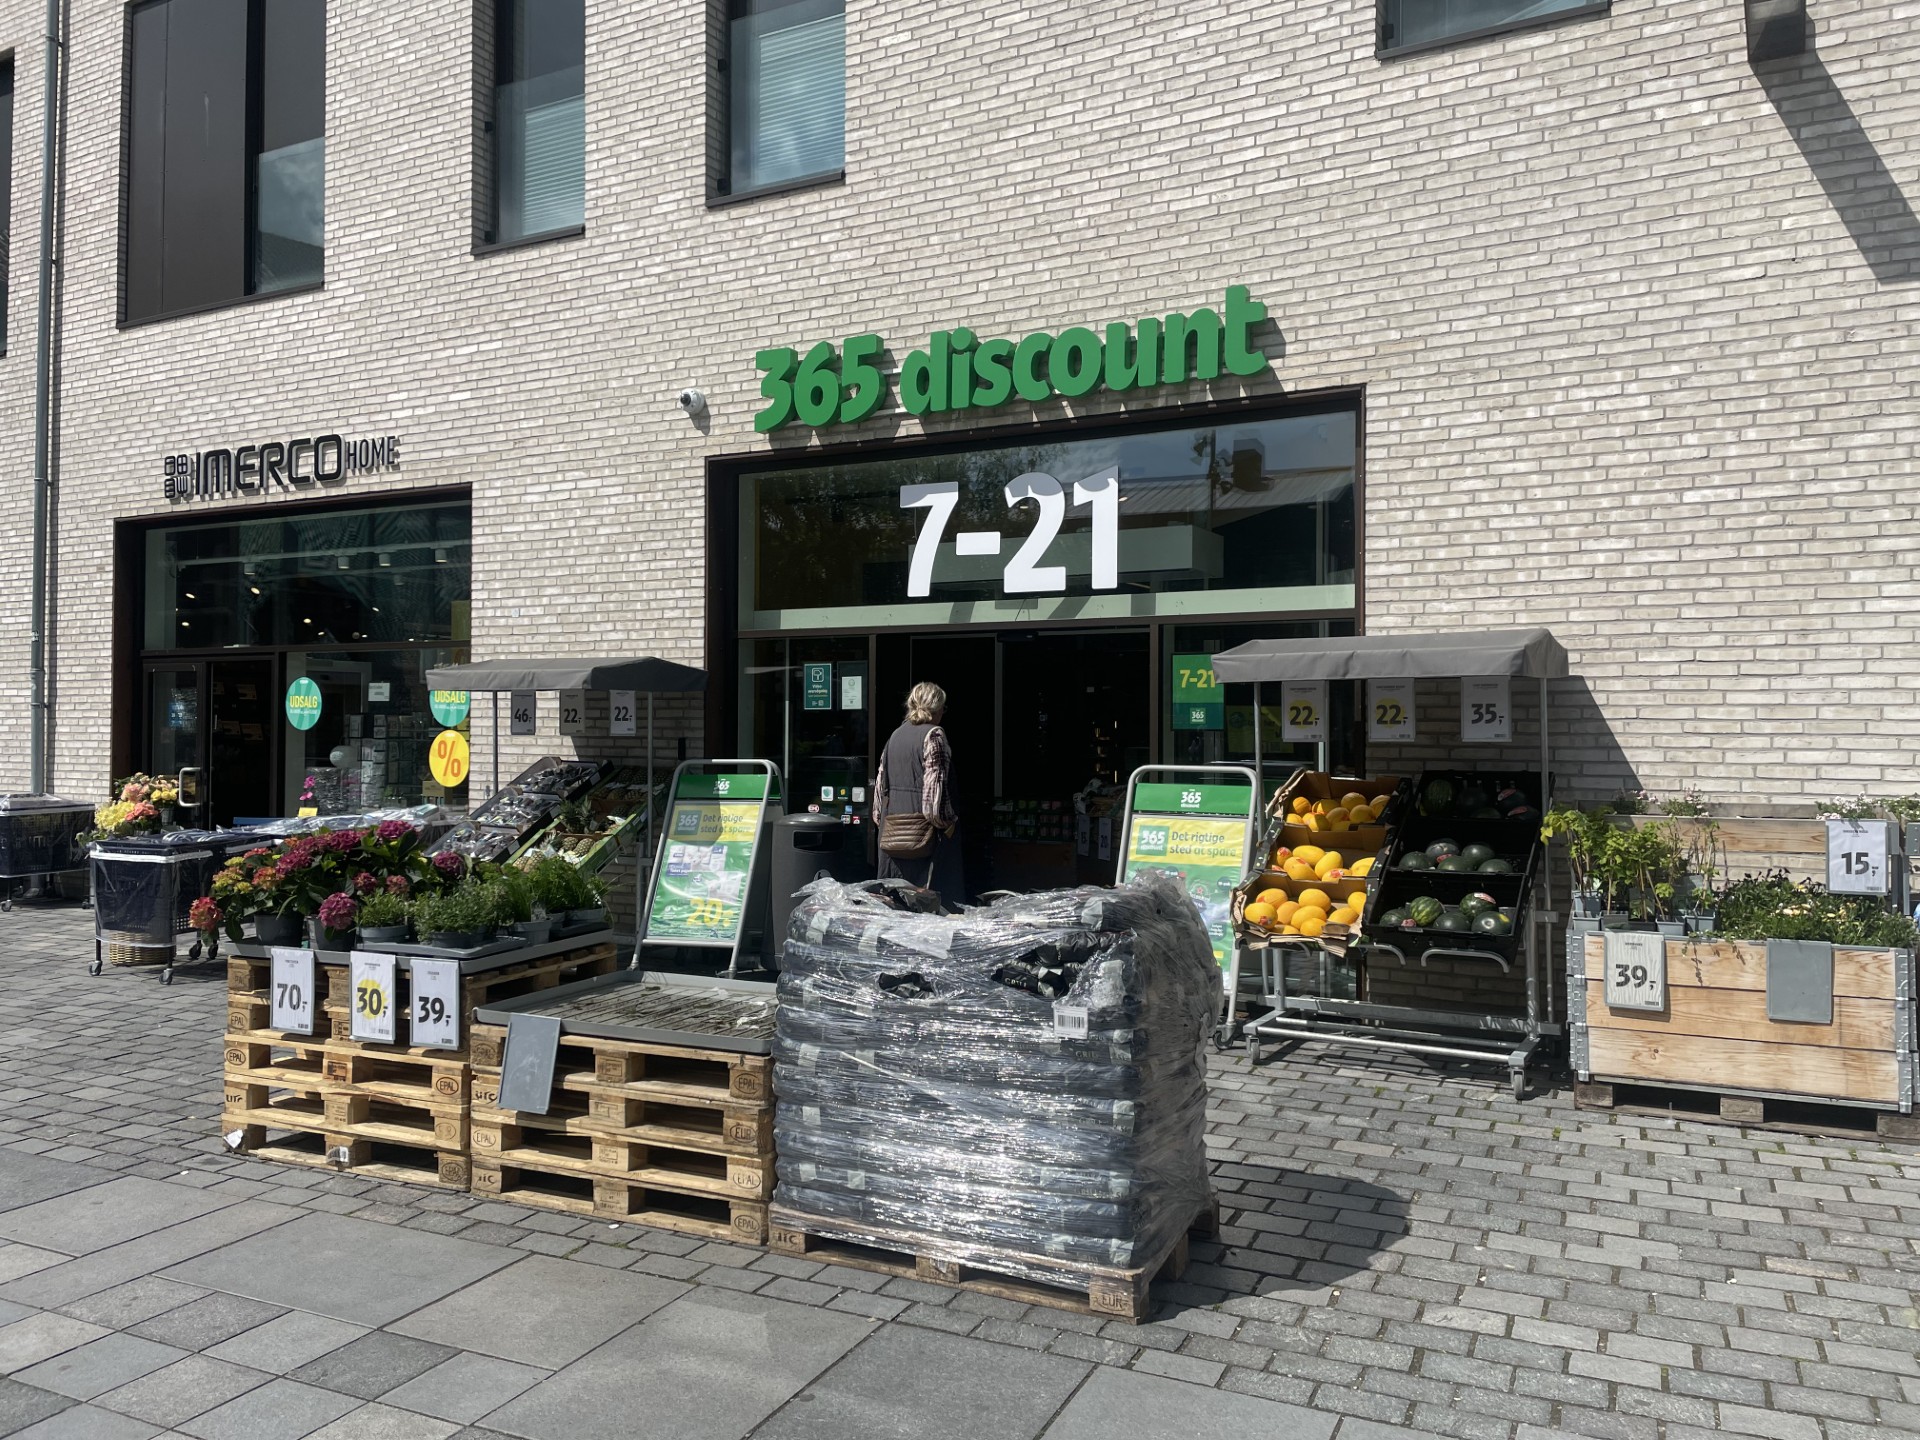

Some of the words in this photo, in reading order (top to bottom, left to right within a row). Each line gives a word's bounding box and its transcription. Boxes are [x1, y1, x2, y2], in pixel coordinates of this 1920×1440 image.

[754, 333, 885, 433] 365
[900, 284, 1270, 417] discount
[346, 436, 400, 471] HOME
[900, 465, 1119, 598] 7-21
[1180, 669, 1216, 688] 7-21
[289, 696, 318, 708] UDSALG
[435, 691, 466, 704] UDSALG
[1191, 711, 1205, 719] 365
[713, 781, 730, 790] 365
[1181, 791, 1202, 804] 365
[679, 814, 698, 827] 365
[703, 814, 716, 822] Det
[701, 825, 718, 833] sted
[1141, 830, 1166, 845] 365
[1172, 831, 1188, 841] Det
[1191, 831, 1225, 845] rigtige
[1170, 844, 1191, 854] sted
[1194, 845, 1205, 855] at
[229, 1052, 242, 1063] EPAL
[439, 1080, 454, 1092] EPAL
[738, 1077, 756, 1090] EPAL
[476, 1132, 492, 1145] EPAL
[738, 1219, 757, 1231] EPAL
